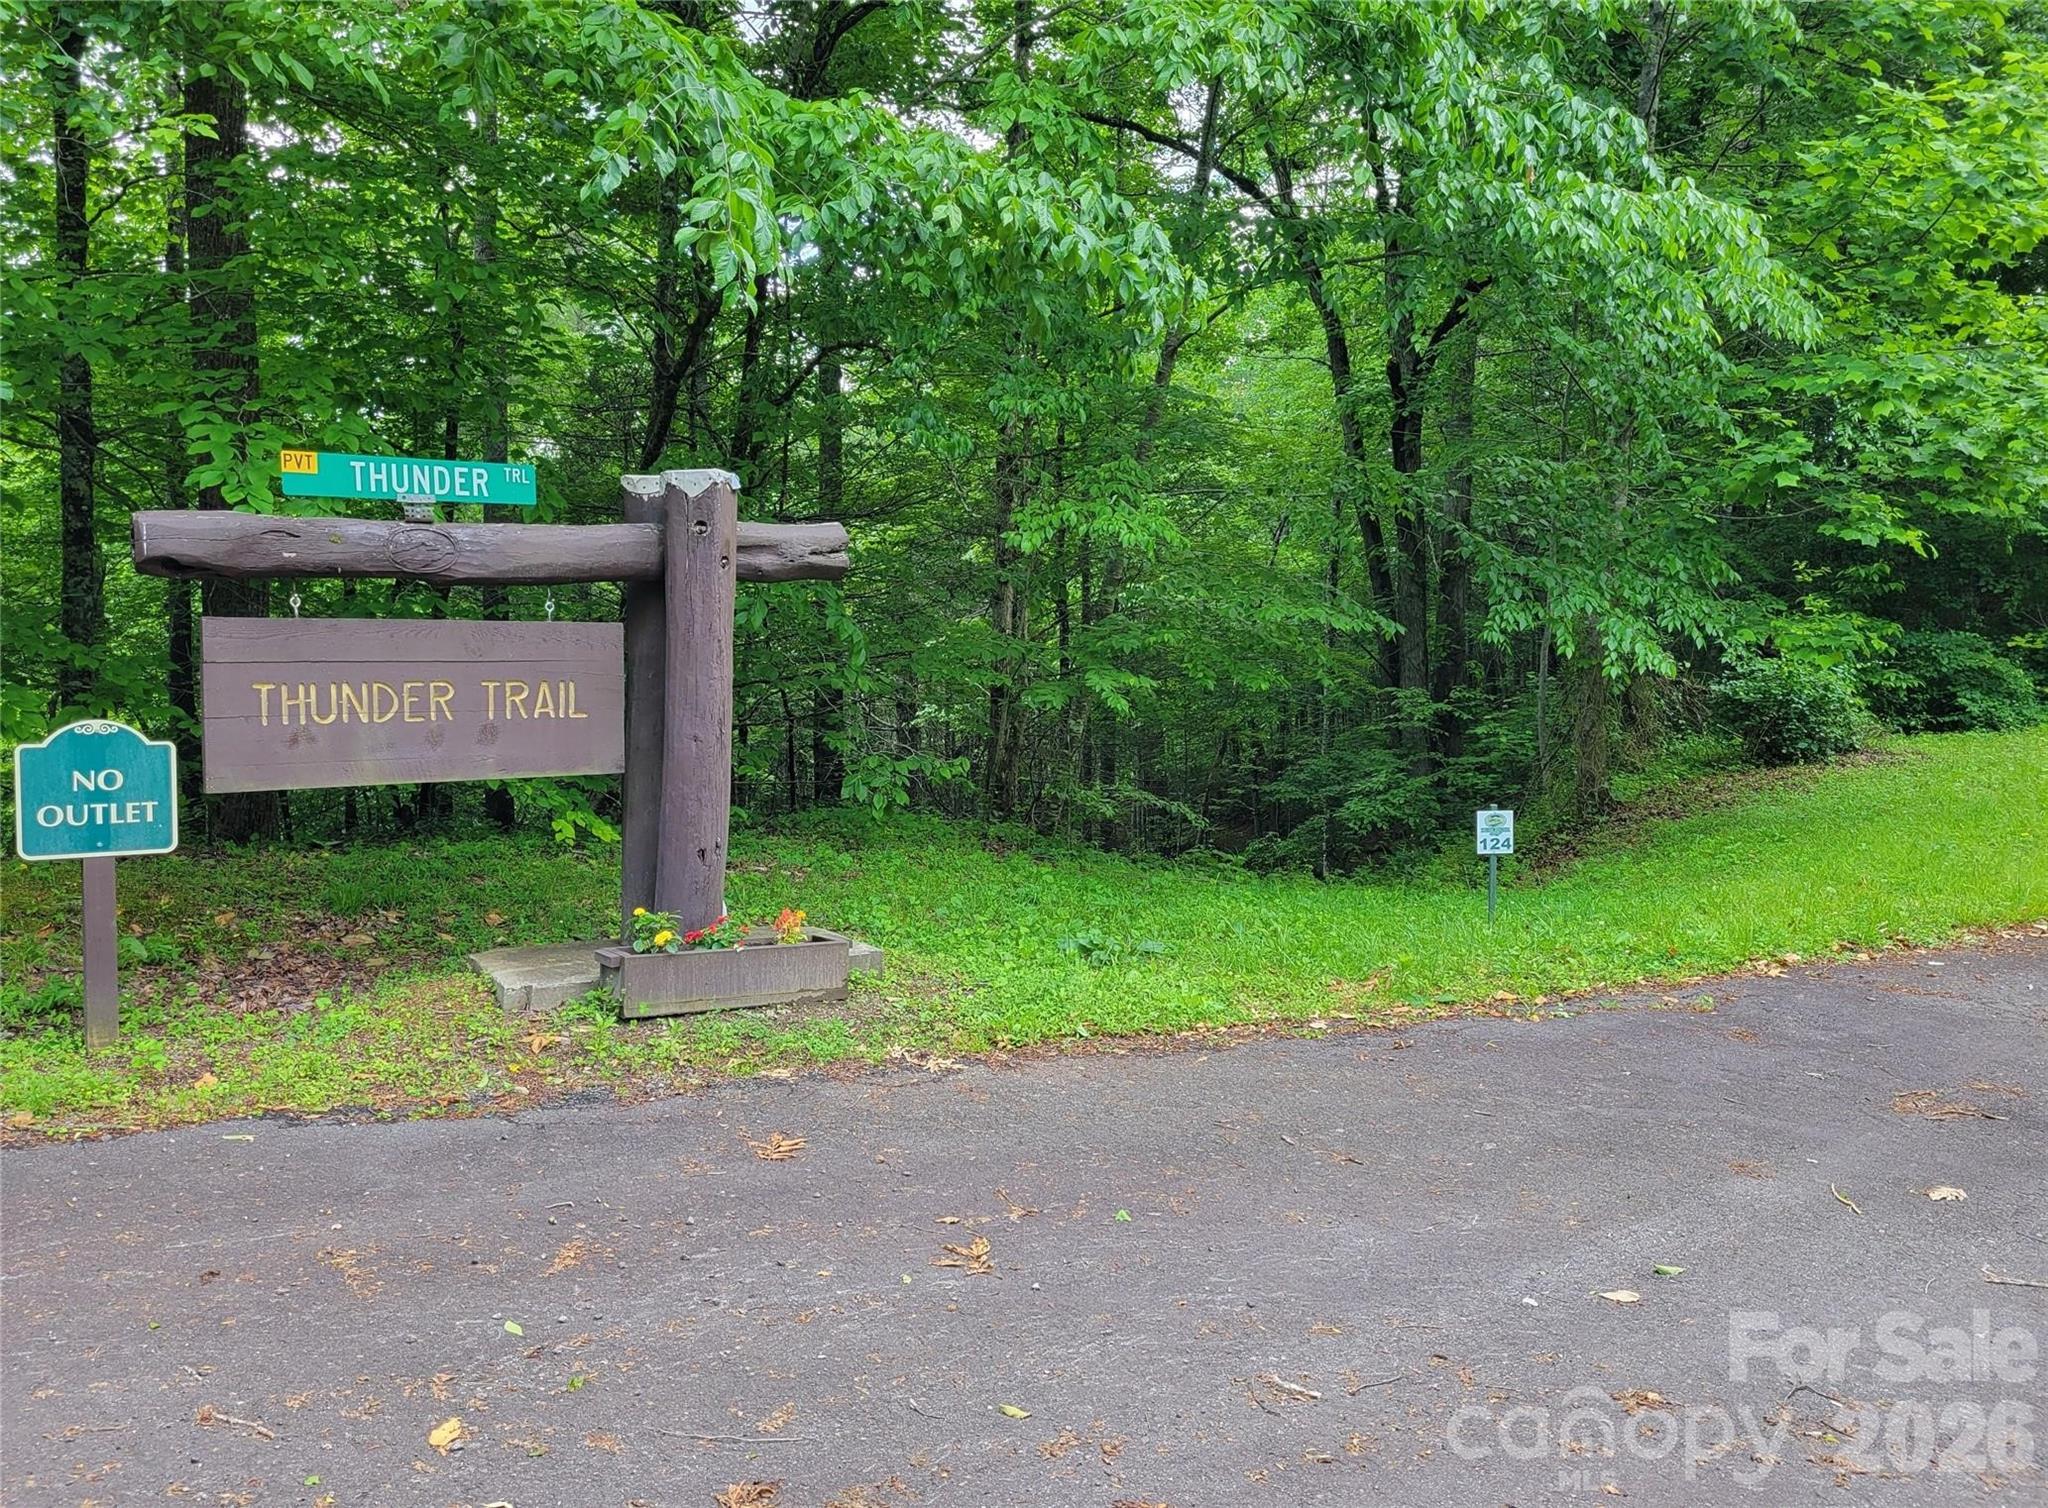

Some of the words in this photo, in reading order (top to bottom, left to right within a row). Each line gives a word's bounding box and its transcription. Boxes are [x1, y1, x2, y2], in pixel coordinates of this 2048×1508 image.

[283, 453, 312, 470] PVT
[350, 461, 489, 497] THUNDER
[504, 467, 530, 484] TRL
[252, 680, 455, 727] THUNDER
[481, 680, 588, 719] TRAIL
[72, 769, 124, 792] NO
[36, 801, 159, 828] OUTLET
[1479, 838, 1512, 850] 124
